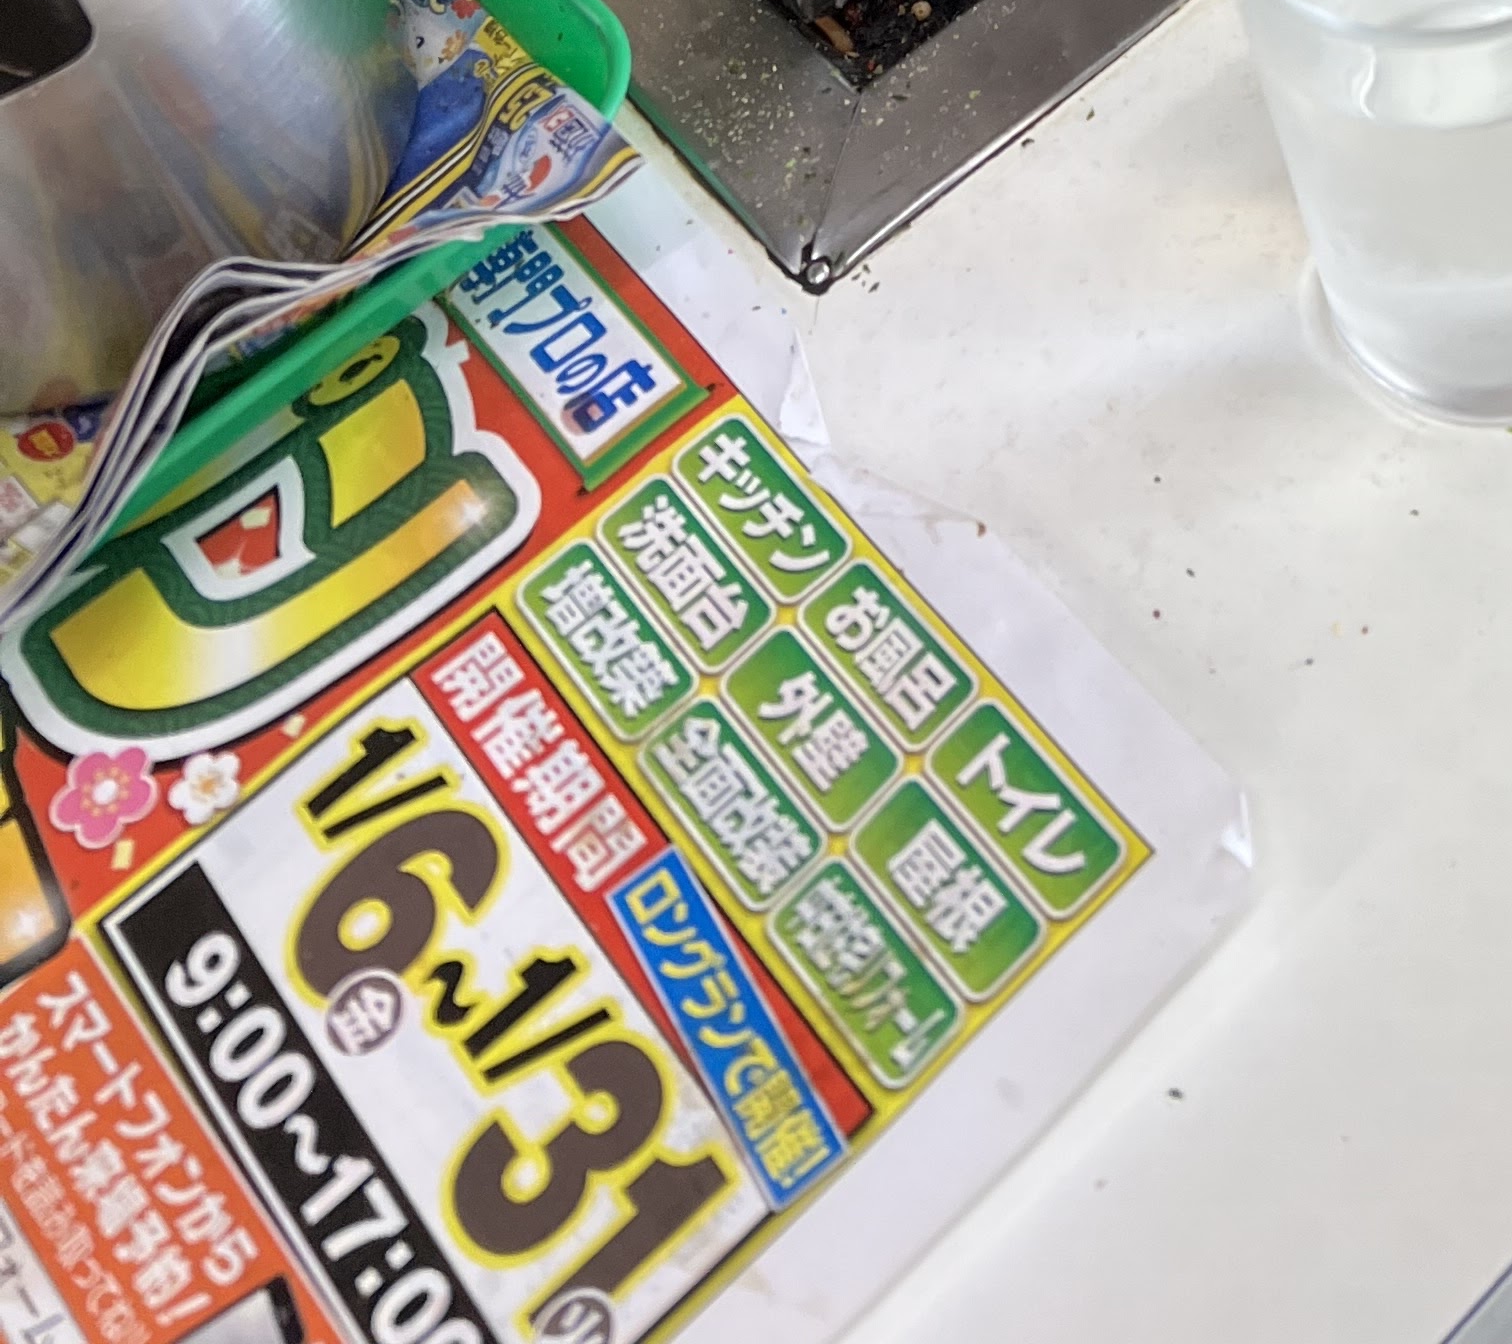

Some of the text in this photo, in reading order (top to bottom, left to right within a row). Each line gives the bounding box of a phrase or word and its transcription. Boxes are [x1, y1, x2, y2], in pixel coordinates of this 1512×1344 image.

[454, 228, 658, 433] 専門プロの店
[617, 494, 751, 652] 洗面台
[696, 432, 830, 574] キッチン
[540, 558, 682, 720] 増改築
[823, 585, 958, 730] お風呂
[430, 630, 650, 893] 開催期間
[652, 715, 820, 895] 全面改装
[758, 668, 871, 795] 外壁
[954, 731, 1087, 877] トイレ
[886, 815, 1010, 955] 屋根
[332, 980, 398, 1053] 金
[624, 875, 831, 1189] ロングランで開催!
[37, 970, 260, 1286] スマートフォンから
